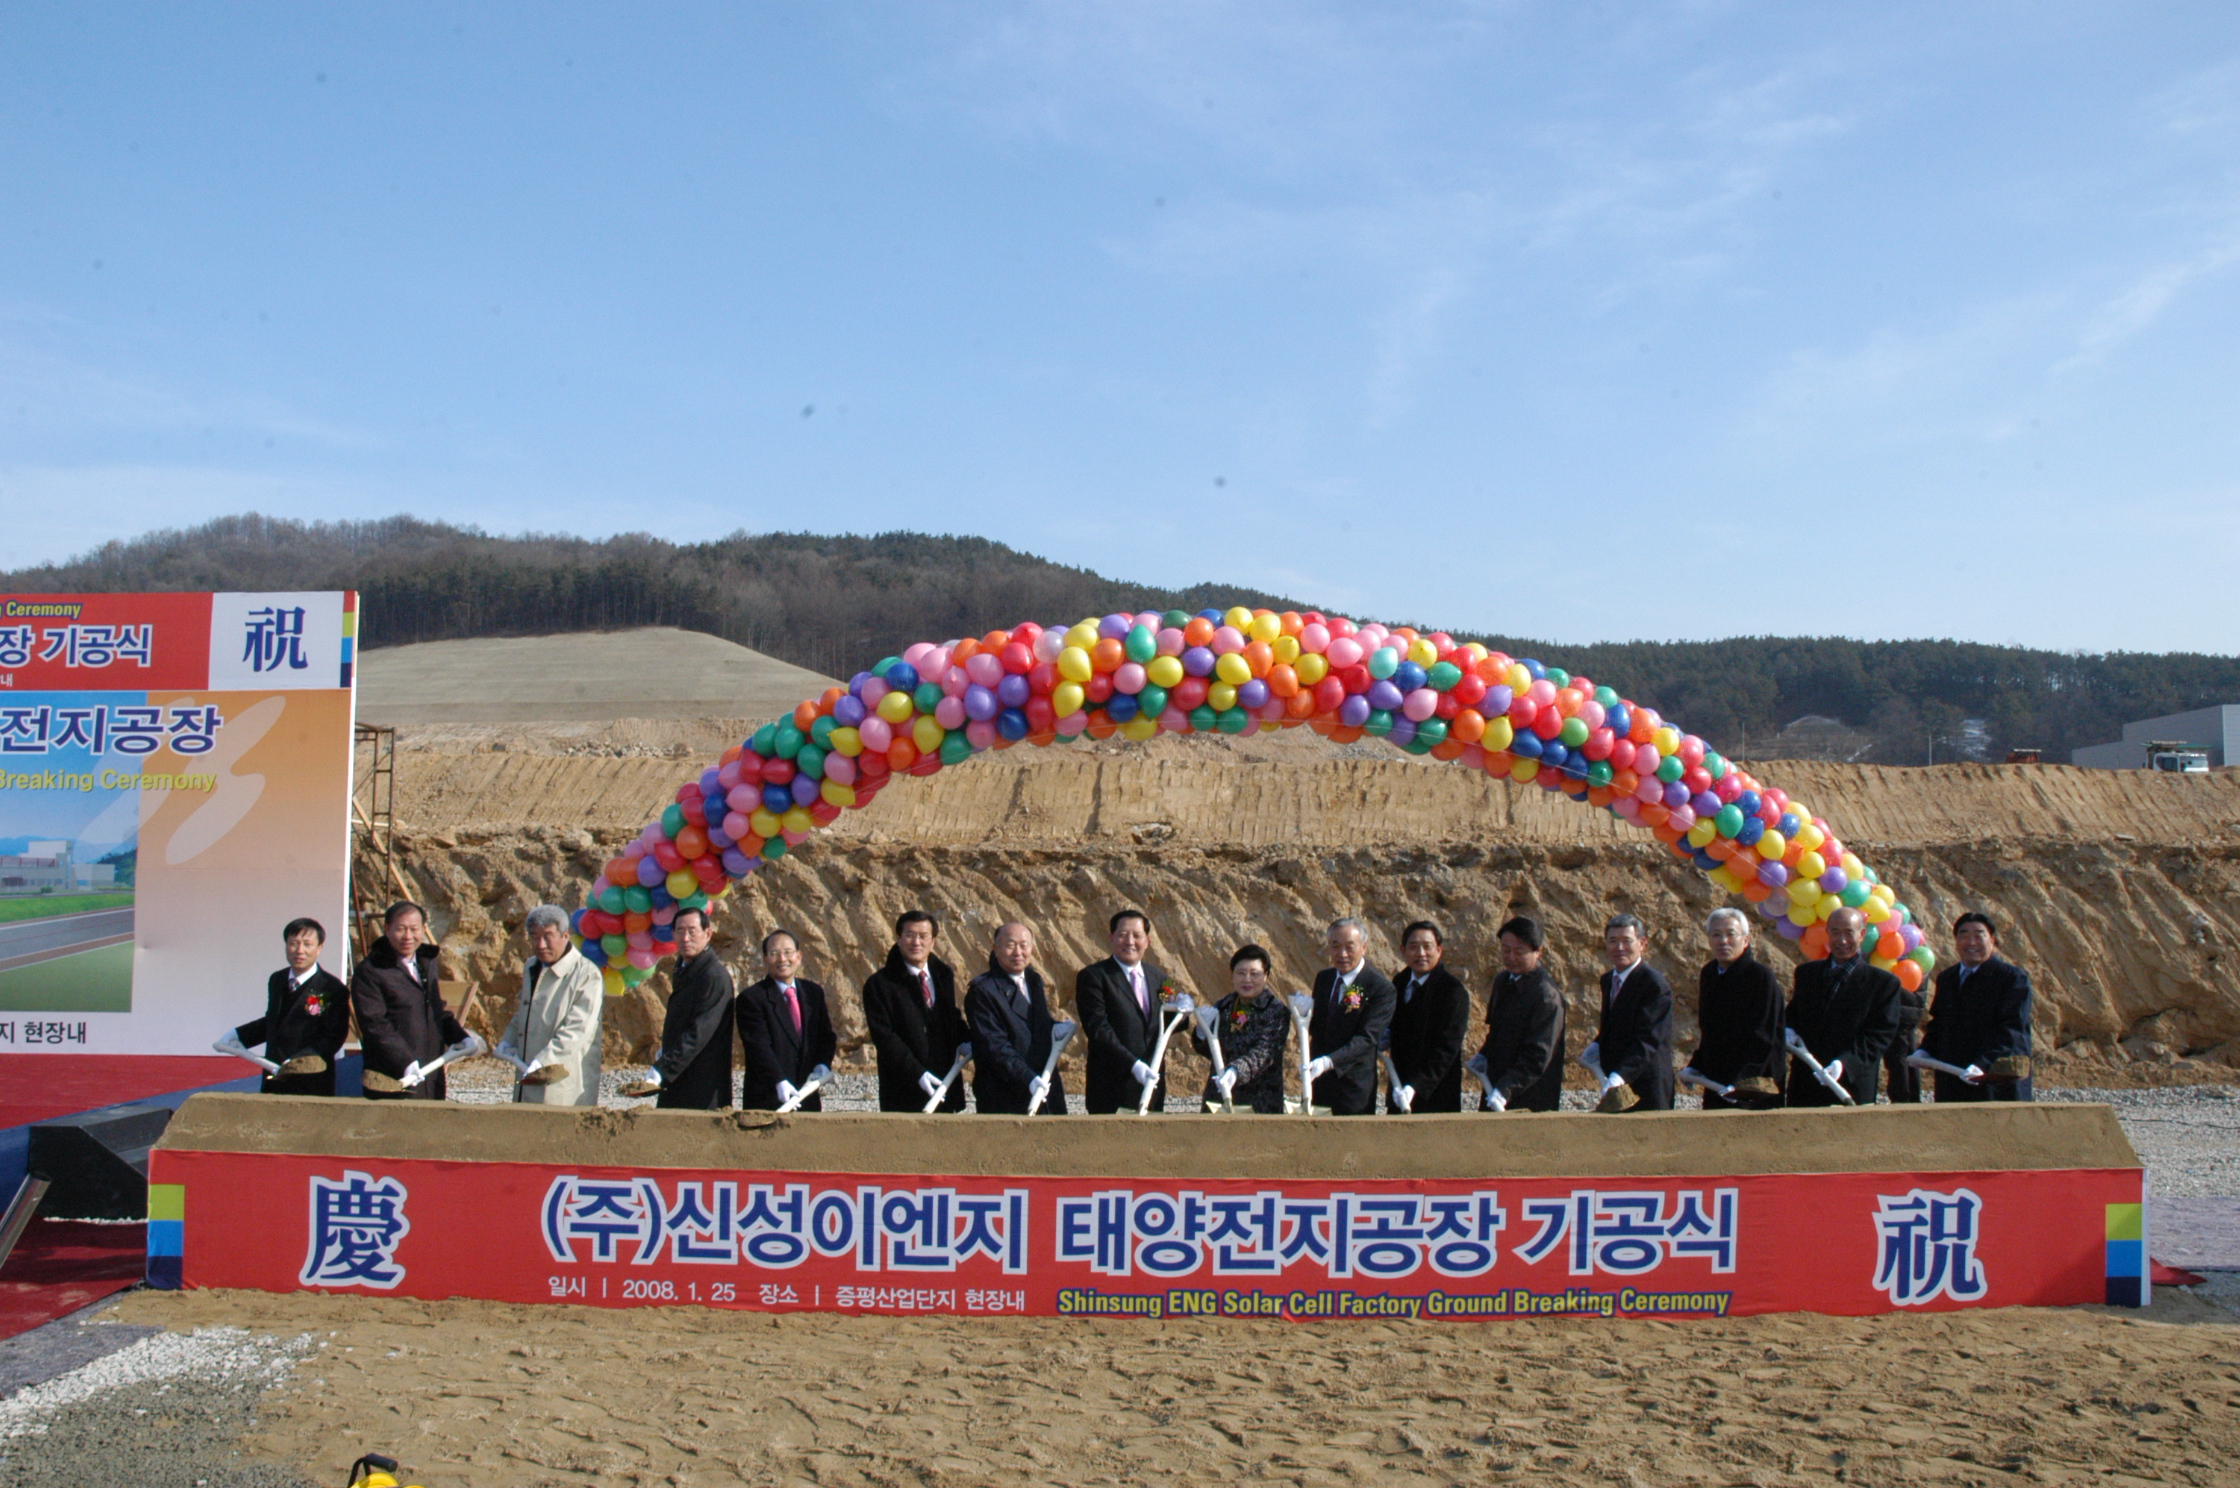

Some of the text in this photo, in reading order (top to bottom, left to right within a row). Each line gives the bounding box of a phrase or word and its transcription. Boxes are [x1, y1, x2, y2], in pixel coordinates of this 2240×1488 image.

[6, 600, 81, 618] Ceremony
[0, 624, 153, 668] 장 기공식
[242, 606, 308, 672] 祝
[0, 705, 223, 756] 전지공장
[0, 770, 216, 793] Breaking Ceremony
[24, 1020, 87, 1044] 현장내
[300, 1170, 409, 1289] 慶
[541, 1175, 1738, 1278] (주)신성이엔지 태양전지공장 기공식
[1872, 1188, 1988, 1305] 祝
[548, 1276, 1025, 1311] 일시 2008. 1. 25 장소 증평산업단지 현장내
[1058, 1288, 1730, 1319] Shinsung ENG Solar Cell Factory Ground Breaking Ceremony
